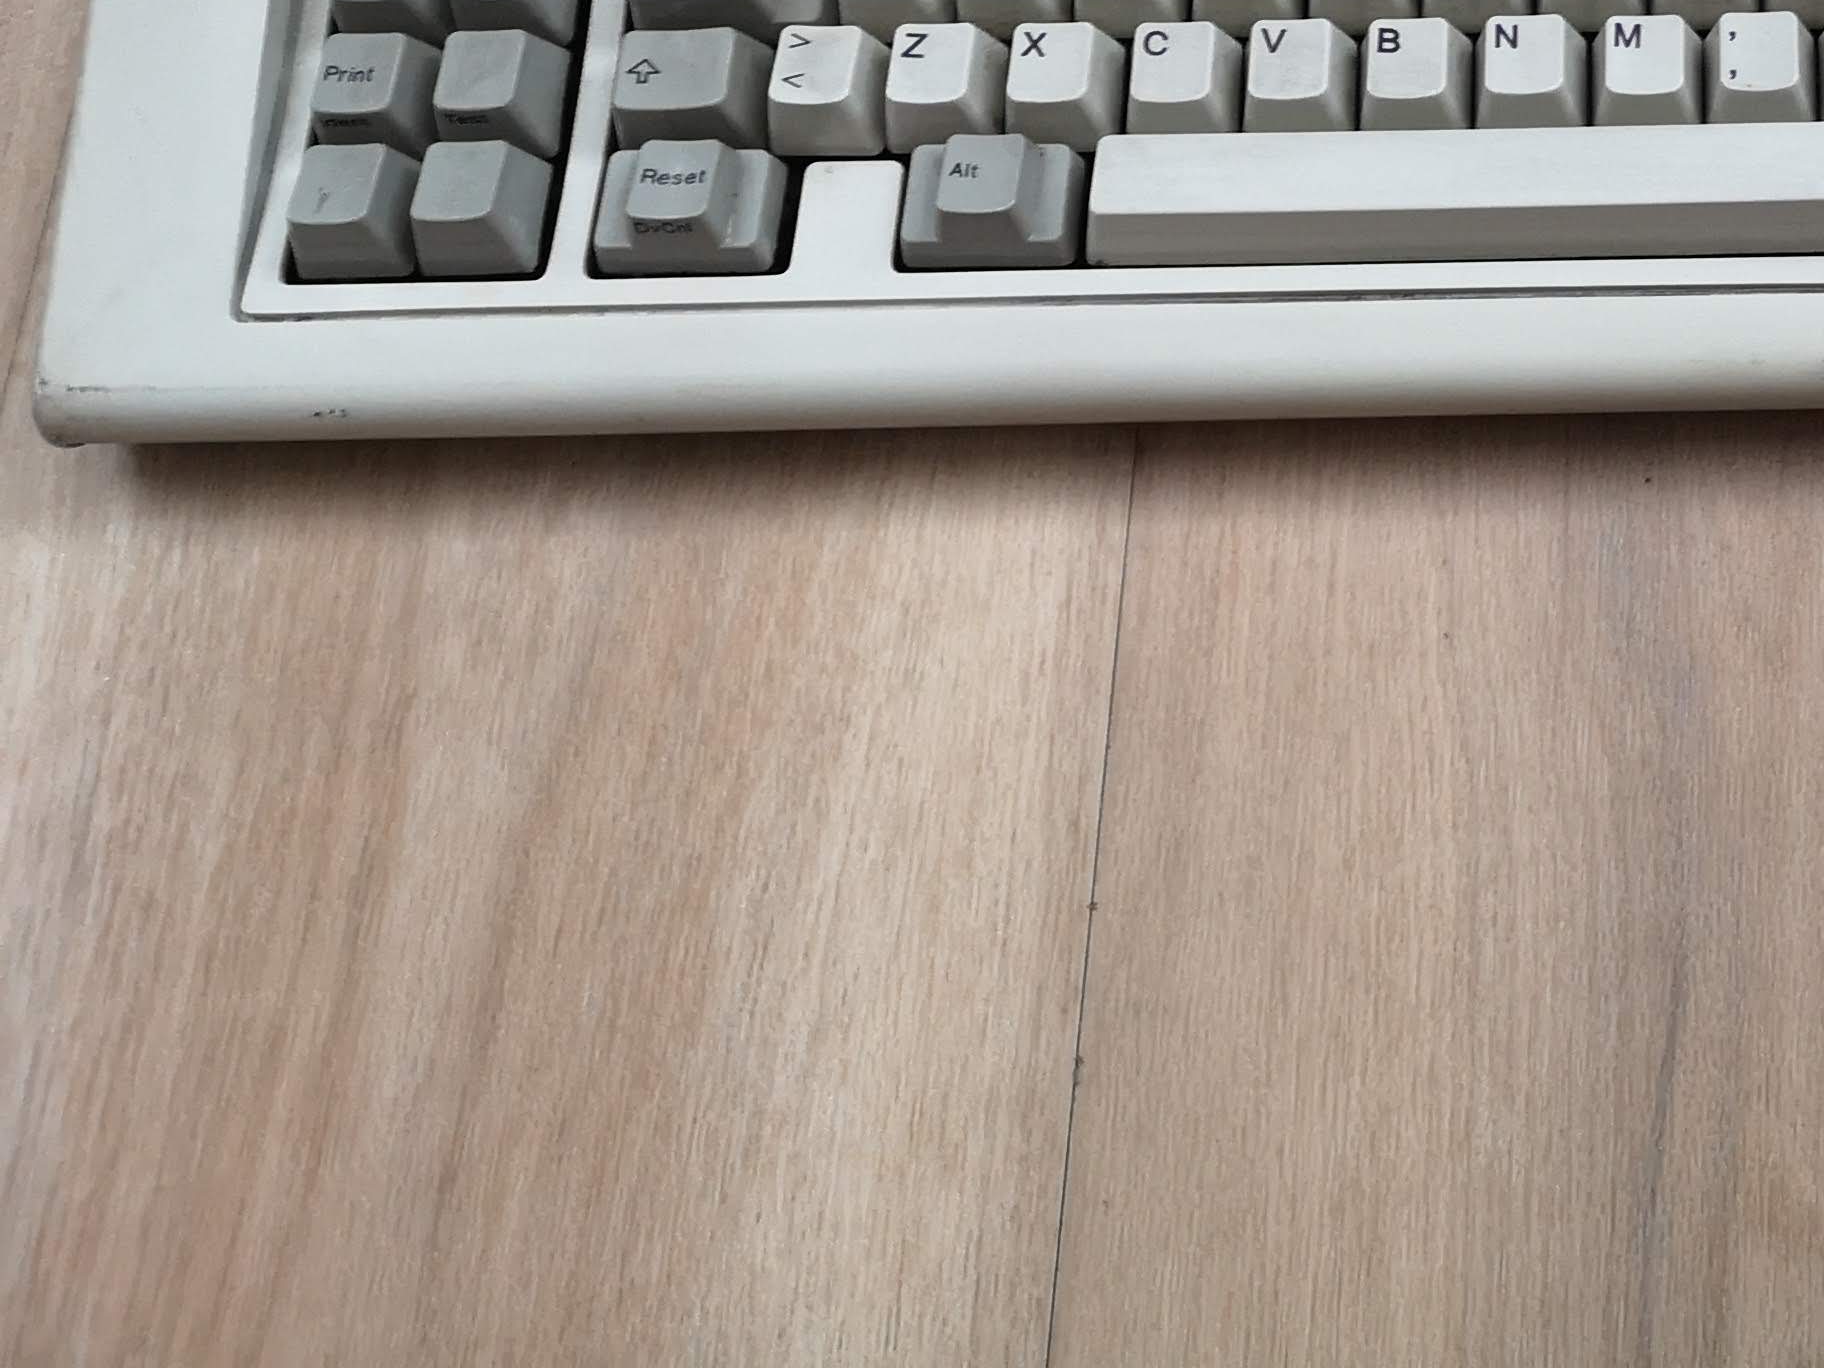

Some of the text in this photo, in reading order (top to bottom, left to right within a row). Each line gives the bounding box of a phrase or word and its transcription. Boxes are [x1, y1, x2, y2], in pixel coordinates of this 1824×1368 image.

[900, 32, 929, 59] Z
[1020, 31, 1047, 58] X
[1142, 30, 1169, 57] C
[1261, 27, 1287, 54] V
[1376, 27, 1401, 54] B
[1494, 23, 1519, 50] N
[1613, 22, 1642, 49] M
[323, 65, 375, 83] Print
[640, 167, 707, 186] Reset
[948, 162, 979, 179] Alt
